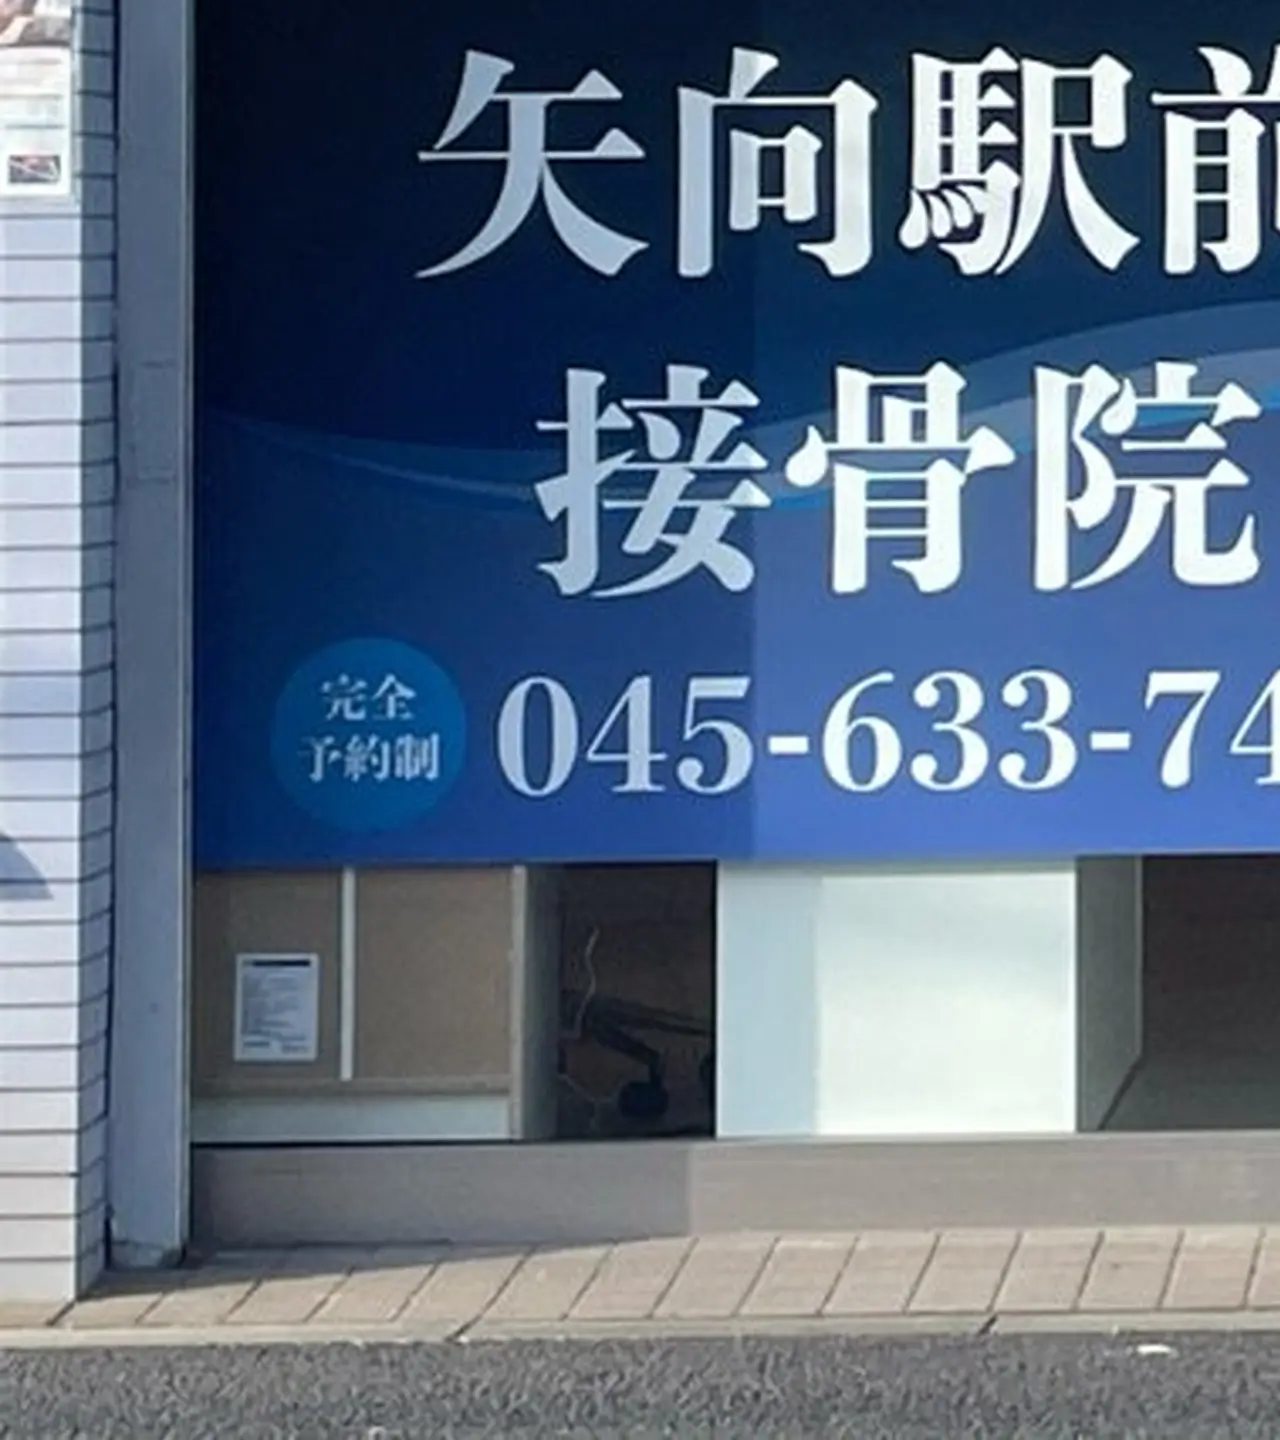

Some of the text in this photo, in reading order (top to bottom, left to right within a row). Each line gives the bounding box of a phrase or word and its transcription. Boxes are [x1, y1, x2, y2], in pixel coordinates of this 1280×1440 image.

[535, 361, 1262, 596] 接骨院
[322, 673, 417, 721] 完全
[299, 732, 440, 782] 予約制
